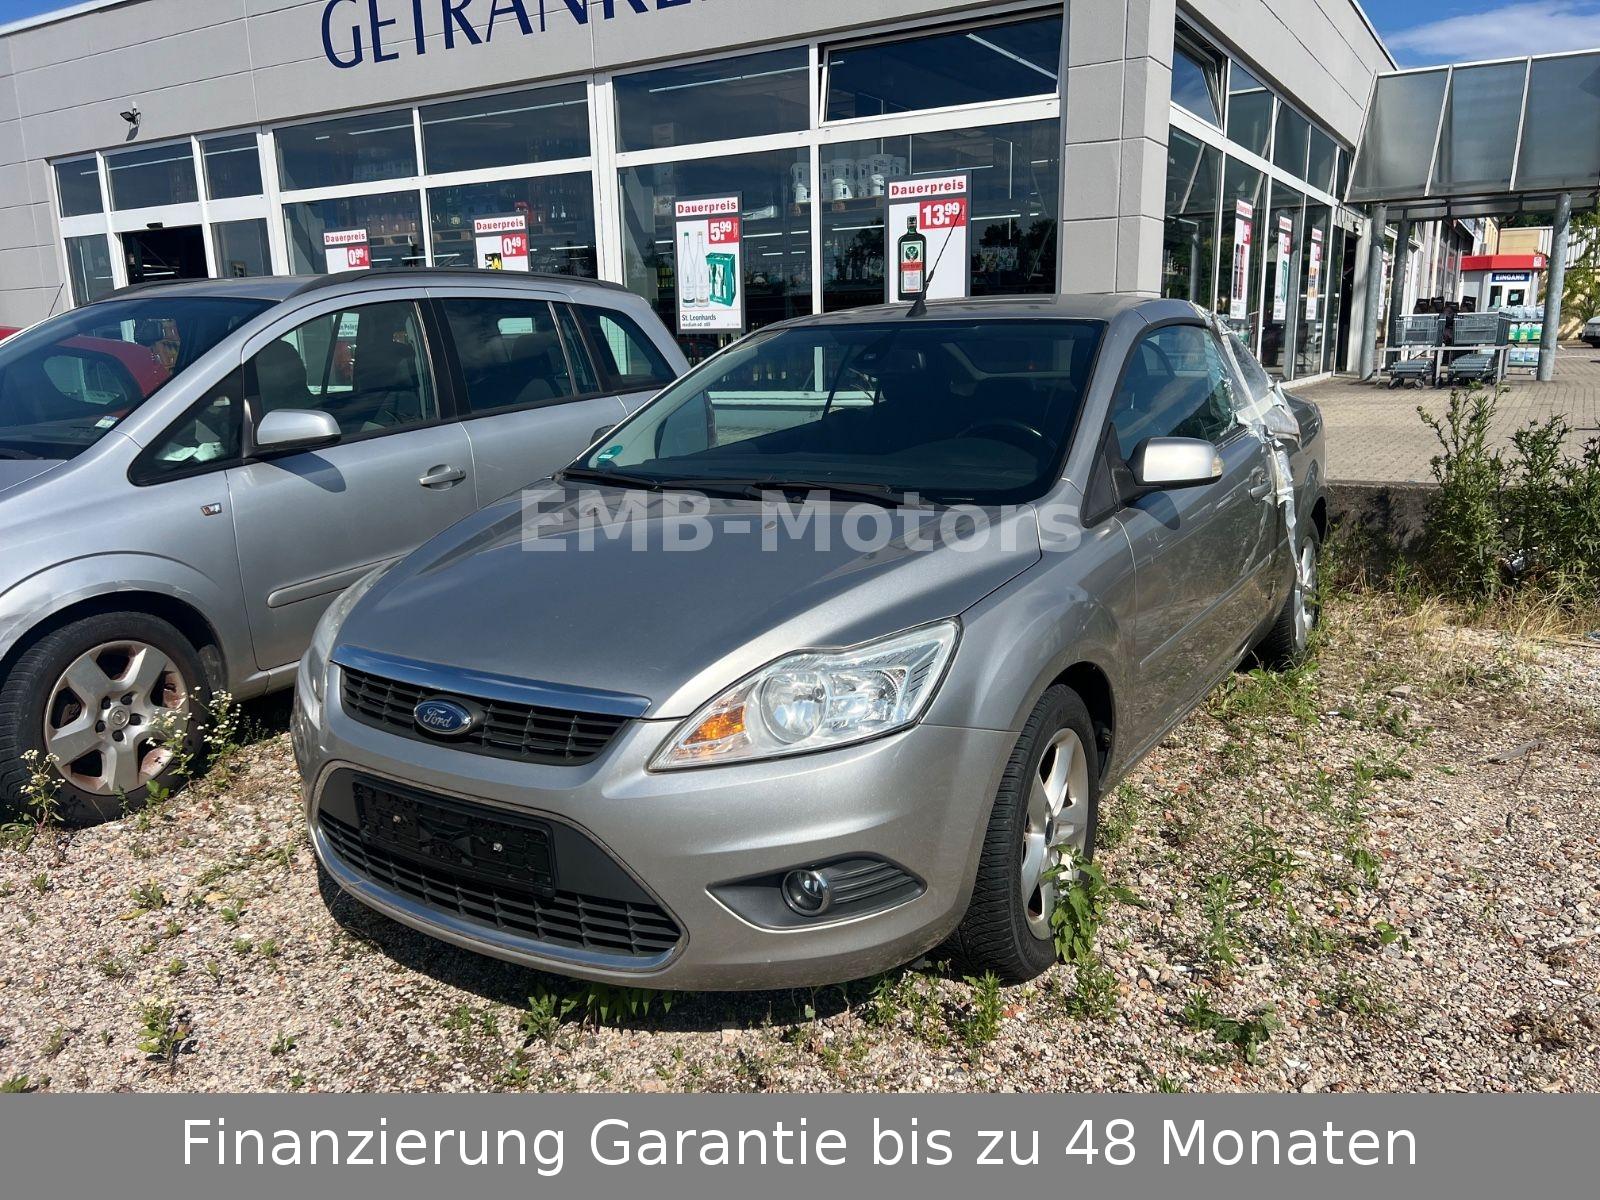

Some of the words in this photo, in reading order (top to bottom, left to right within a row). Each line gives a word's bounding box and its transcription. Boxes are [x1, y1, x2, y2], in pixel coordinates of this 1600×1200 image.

[322, 0, 693, 69] GETR
[891, 180, 965, 195] Dauerpreis
[677, 201, 737, 213] Dauerpreis
[922, 202, 960, 226] 13.99
[476, 219, 524, 230] Dauerpreis
[710, 221, 732, 241] 5.99
[325, 233, 366, 243] Dauerpreis
[423, 706, 453, 728] Ford
